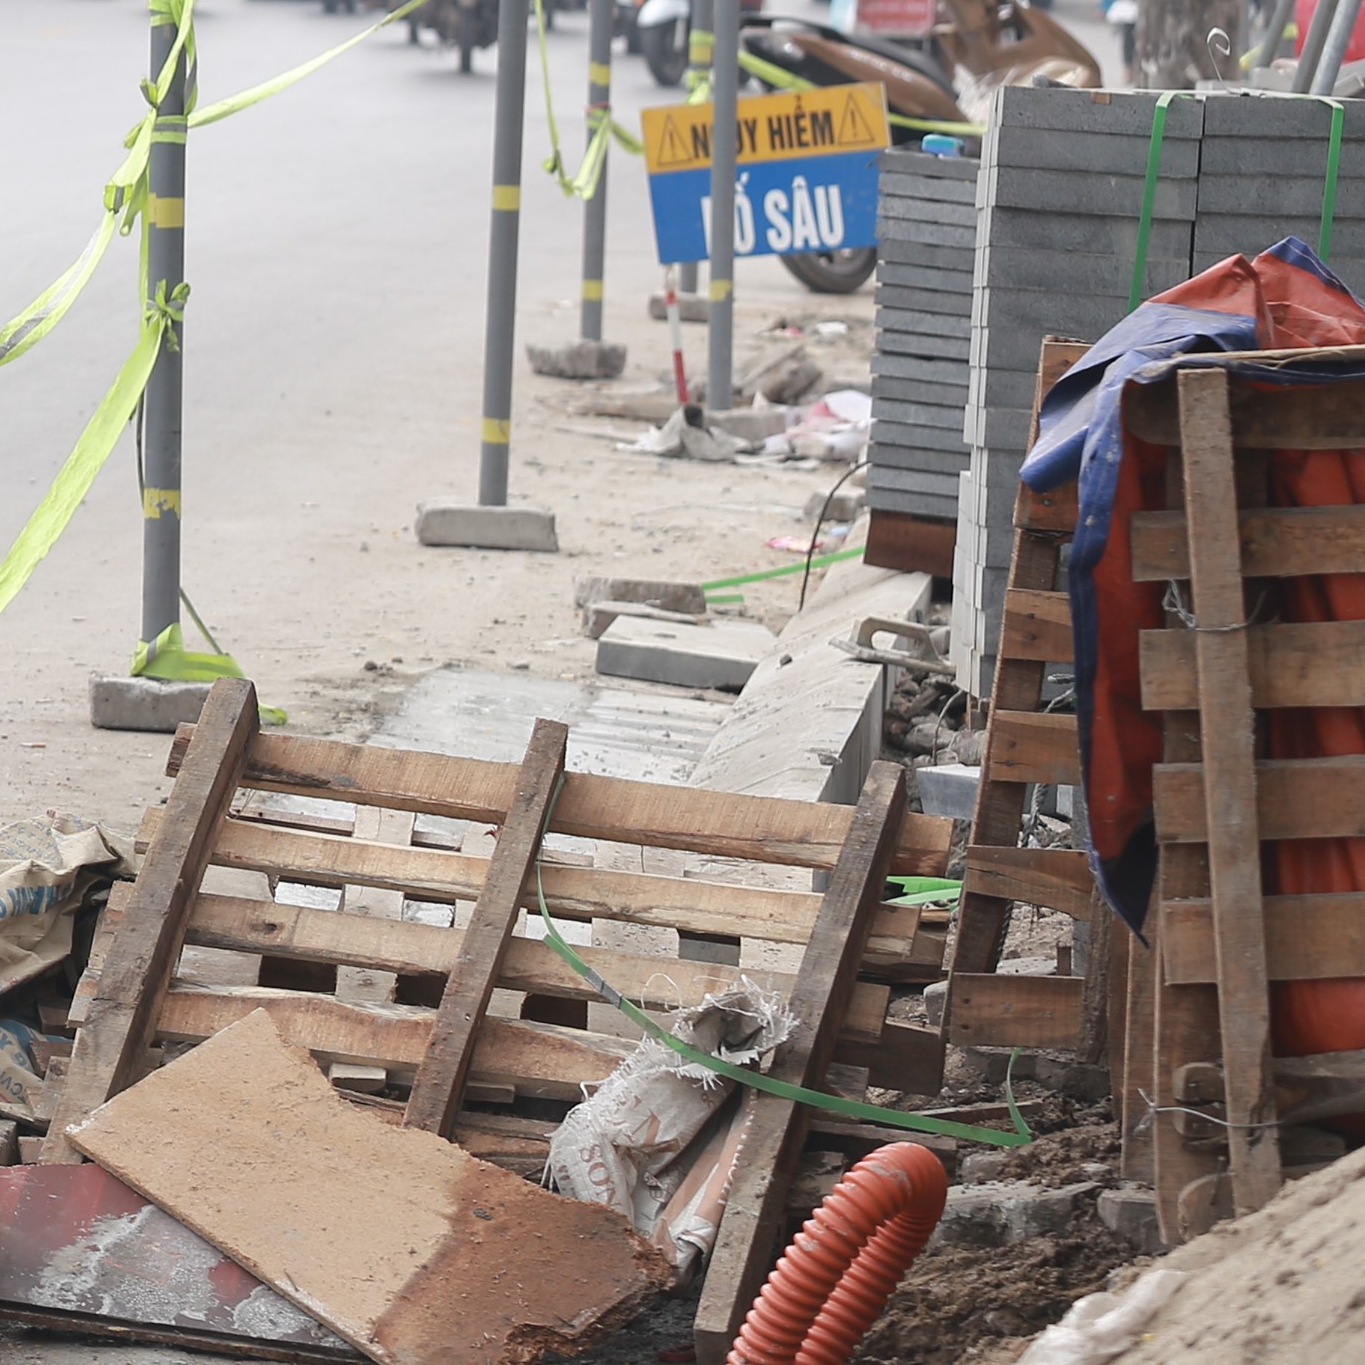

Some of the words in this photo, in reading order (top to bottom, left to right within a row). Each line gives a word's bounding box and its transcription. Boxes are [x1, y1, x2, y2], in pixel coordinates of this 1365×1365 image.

[691, 117, 758, 160] NUY
[768, 94, 836, 152] HIỂM
[763, 175, 845, 253] SÂU
